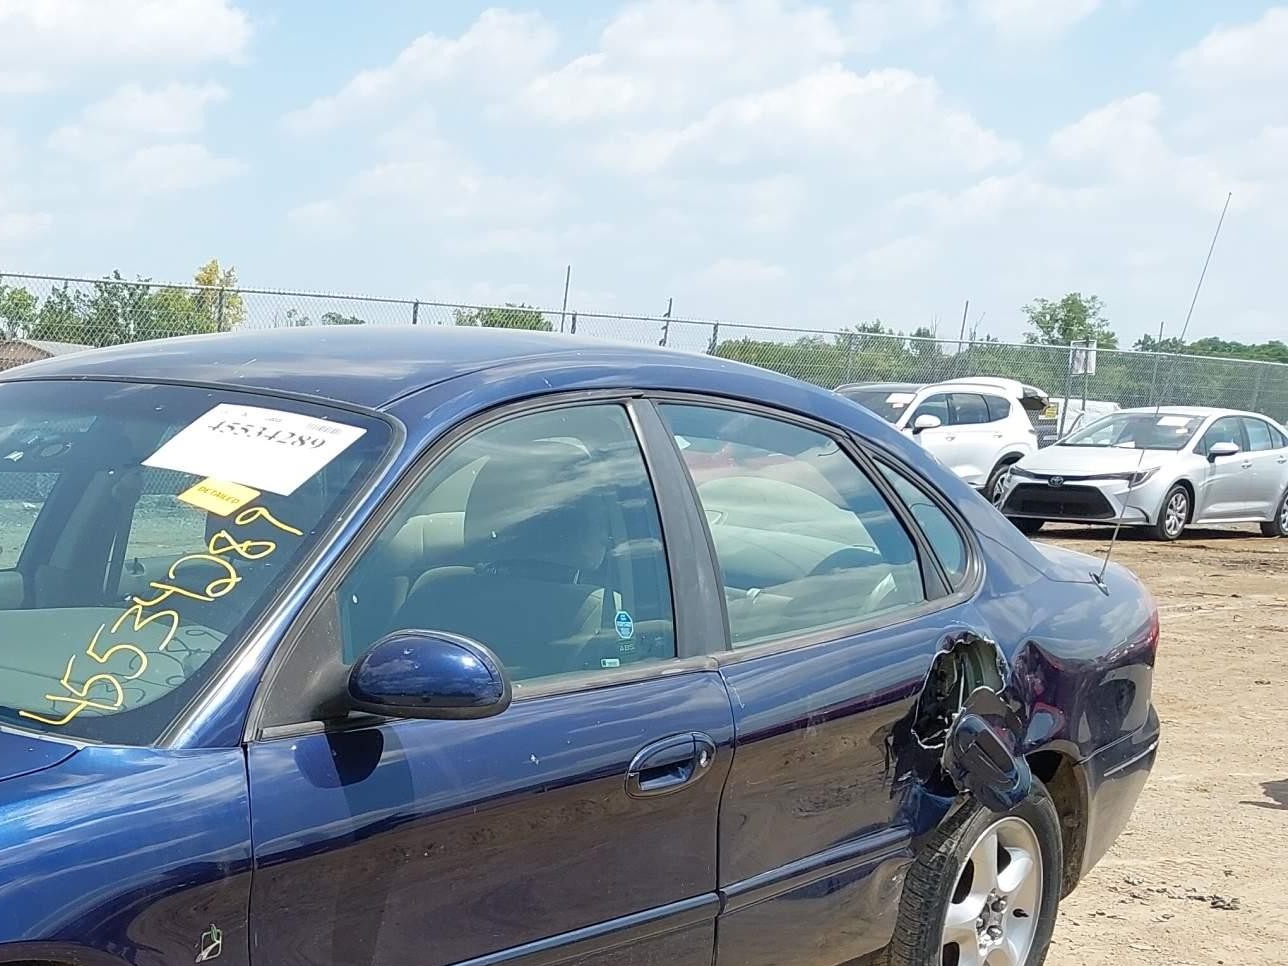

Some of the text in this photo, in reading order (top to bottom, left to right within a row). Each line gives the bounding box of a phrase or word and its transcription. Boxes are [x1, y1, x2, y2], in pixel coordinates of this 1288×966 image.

[208, 420, 326, 448] 45534289
[198, 486, 240, 504] DETAILED
[19, 507, 304, 725] 45534289
